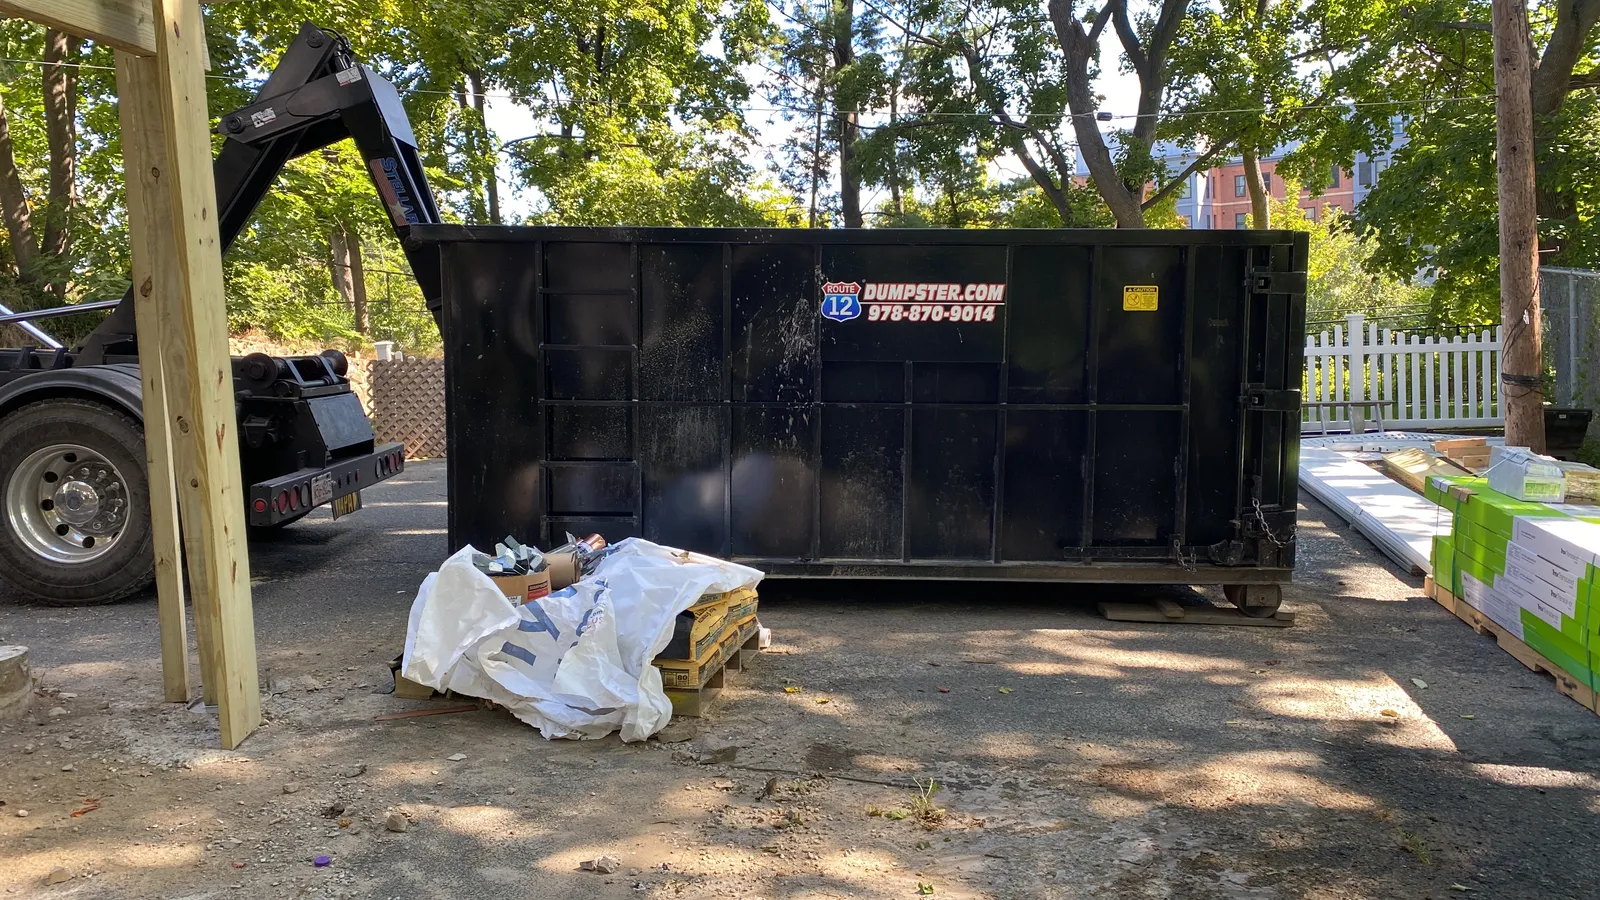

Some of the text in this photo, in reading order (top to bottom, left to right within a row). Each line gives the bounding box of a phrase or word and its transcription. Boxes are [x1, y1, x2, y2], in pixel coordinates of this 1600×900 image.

[826, 285, 855, 294] ROUTE
[863, 283, 1005, 301] DUMPSTER.COM
[829, 296, 853, 317] 12
[867, 304, 996, 321] 978-870-9014
